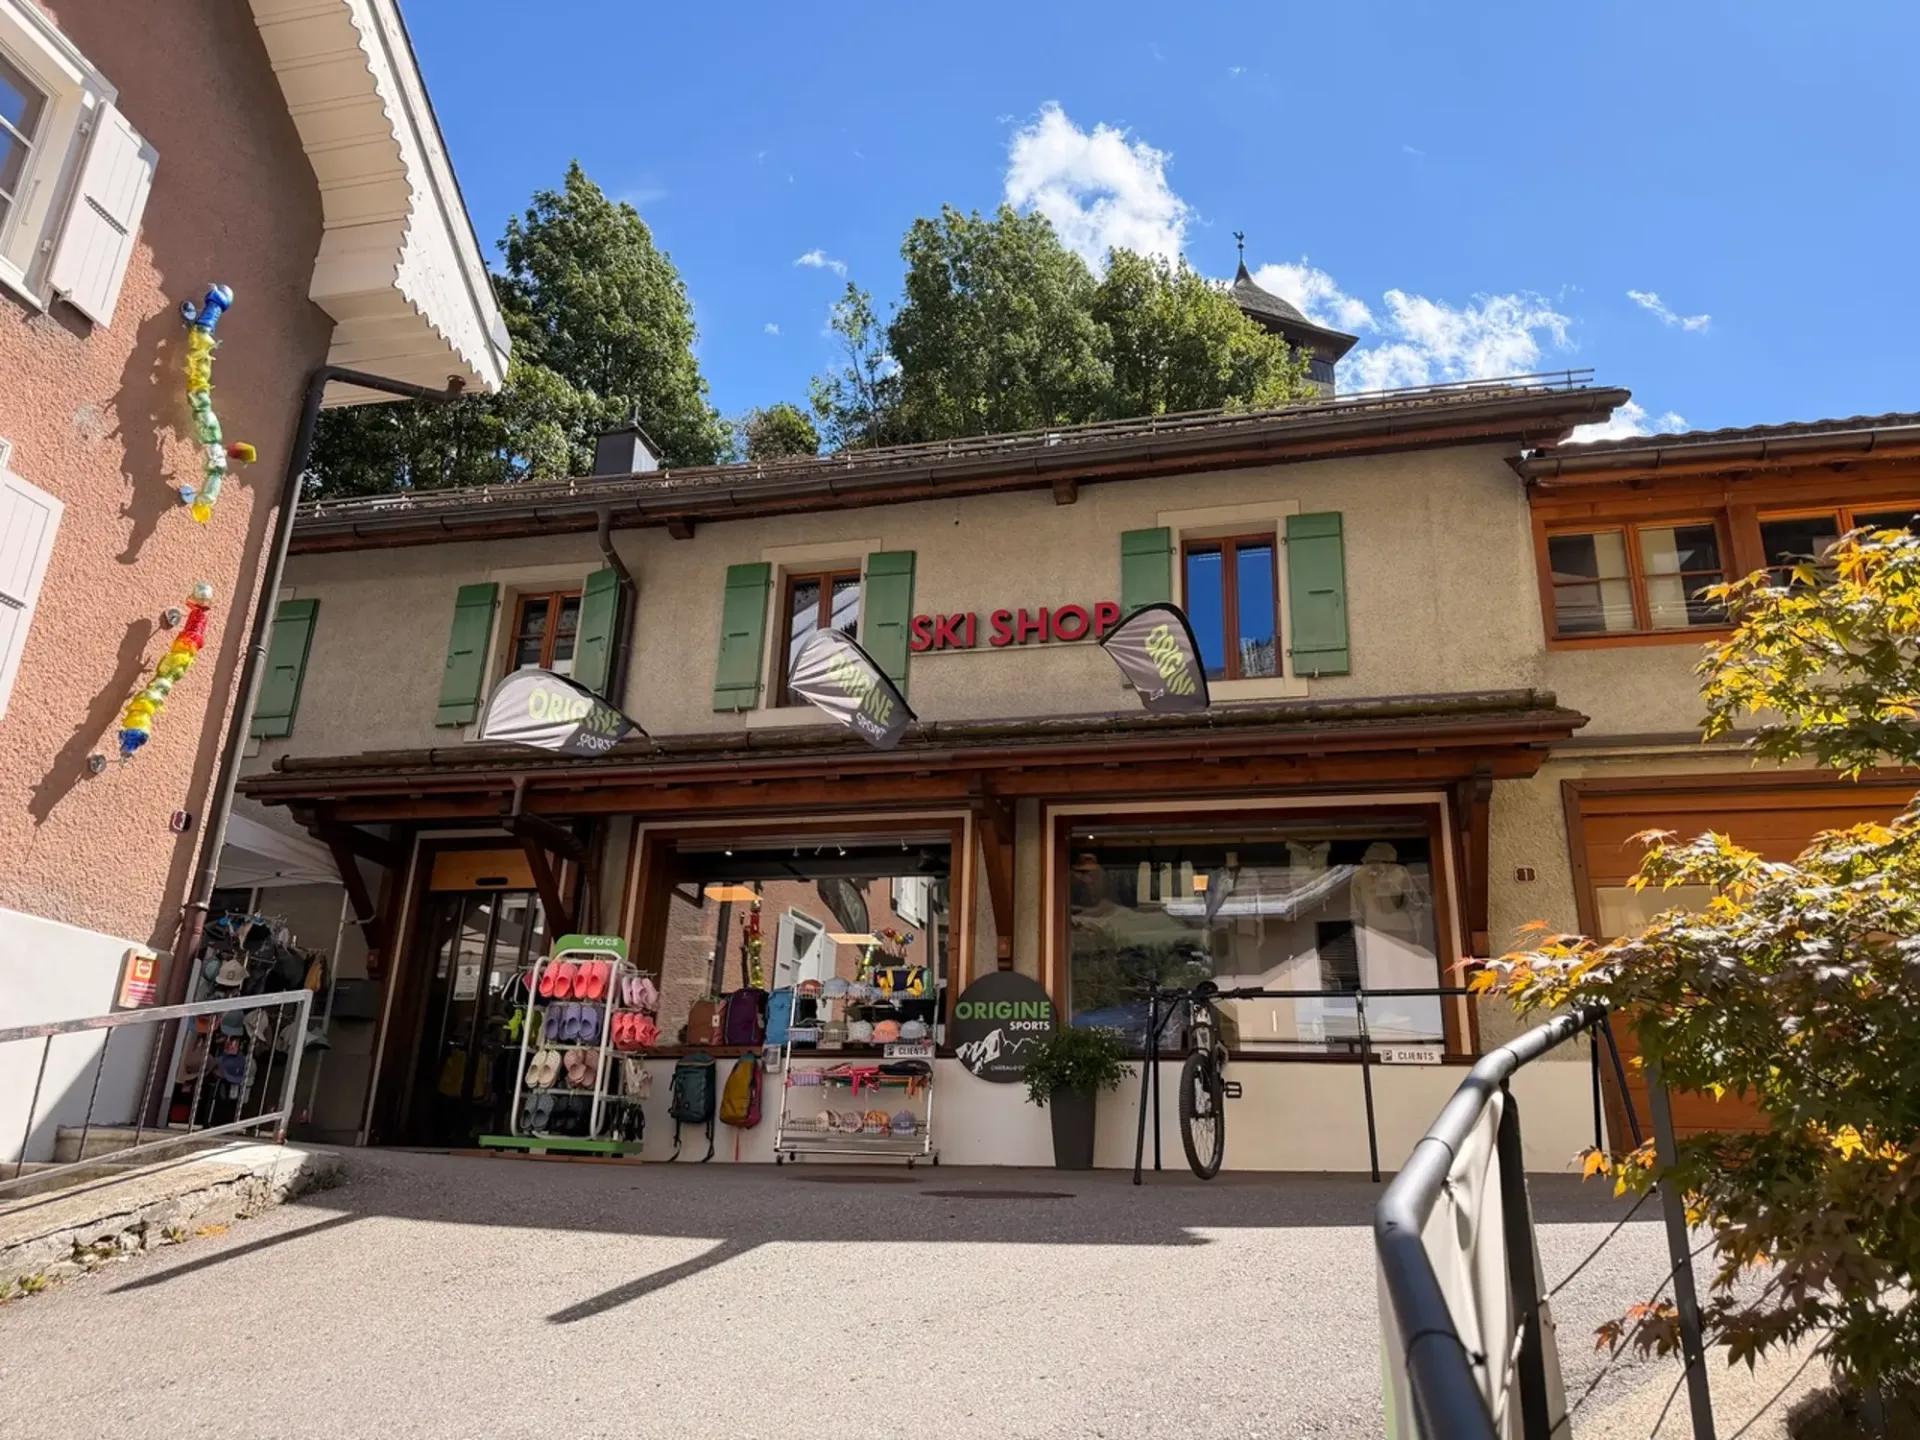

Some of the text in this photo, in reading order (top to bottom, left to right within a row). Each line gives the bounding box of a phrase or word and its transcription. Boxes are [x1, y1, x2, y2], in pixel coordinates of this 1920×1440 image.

[910, 602, 1120, 652] SKI SHOP
[528, 688, 623, 736] ORIGINE
[583, 936, 619, 946] crocs
[955, 1001, 1051, 1019] ORIGINE
[1009, 1021, 1051, 1031] SPORTS
[898, 1046, 929, 1056] CLIENTS
[1397, 1051, 1435, 1061] CLIENTS
